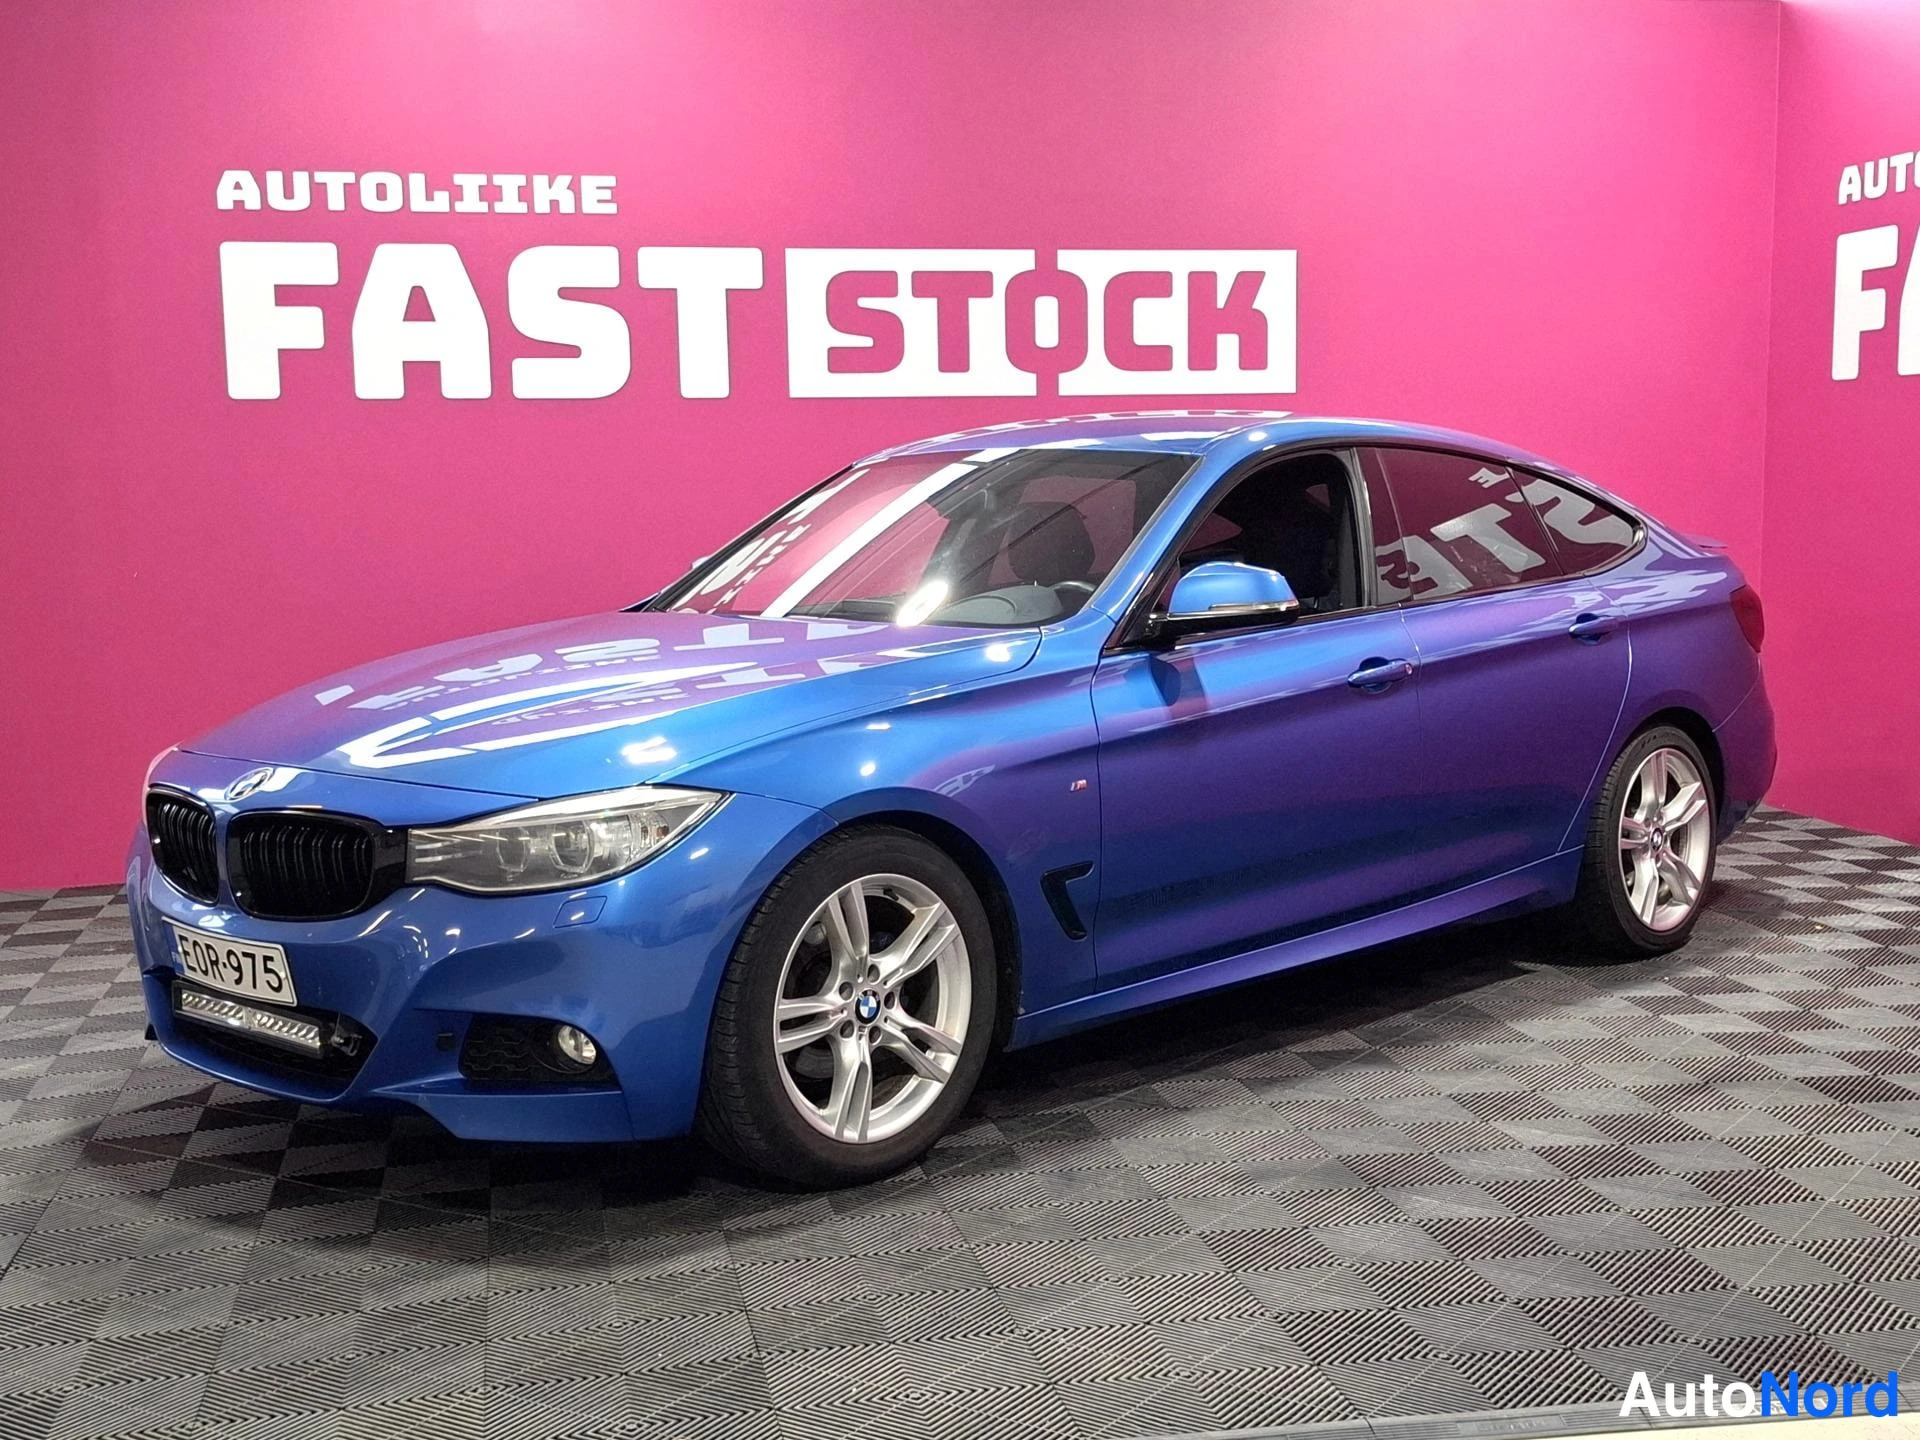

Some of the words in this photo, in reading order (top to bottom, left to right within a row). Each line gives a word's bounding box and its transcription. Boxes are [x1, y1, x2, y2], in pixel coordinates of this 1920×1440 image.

[216, 170, 618, 214] AUTOLIIKE
[219, 241, 764, 400] FAST
[825, 270, 1268, 374] STOCK
[1831, 224, 1920, 381] F
[178, 934, 284, 993] EOR-975
